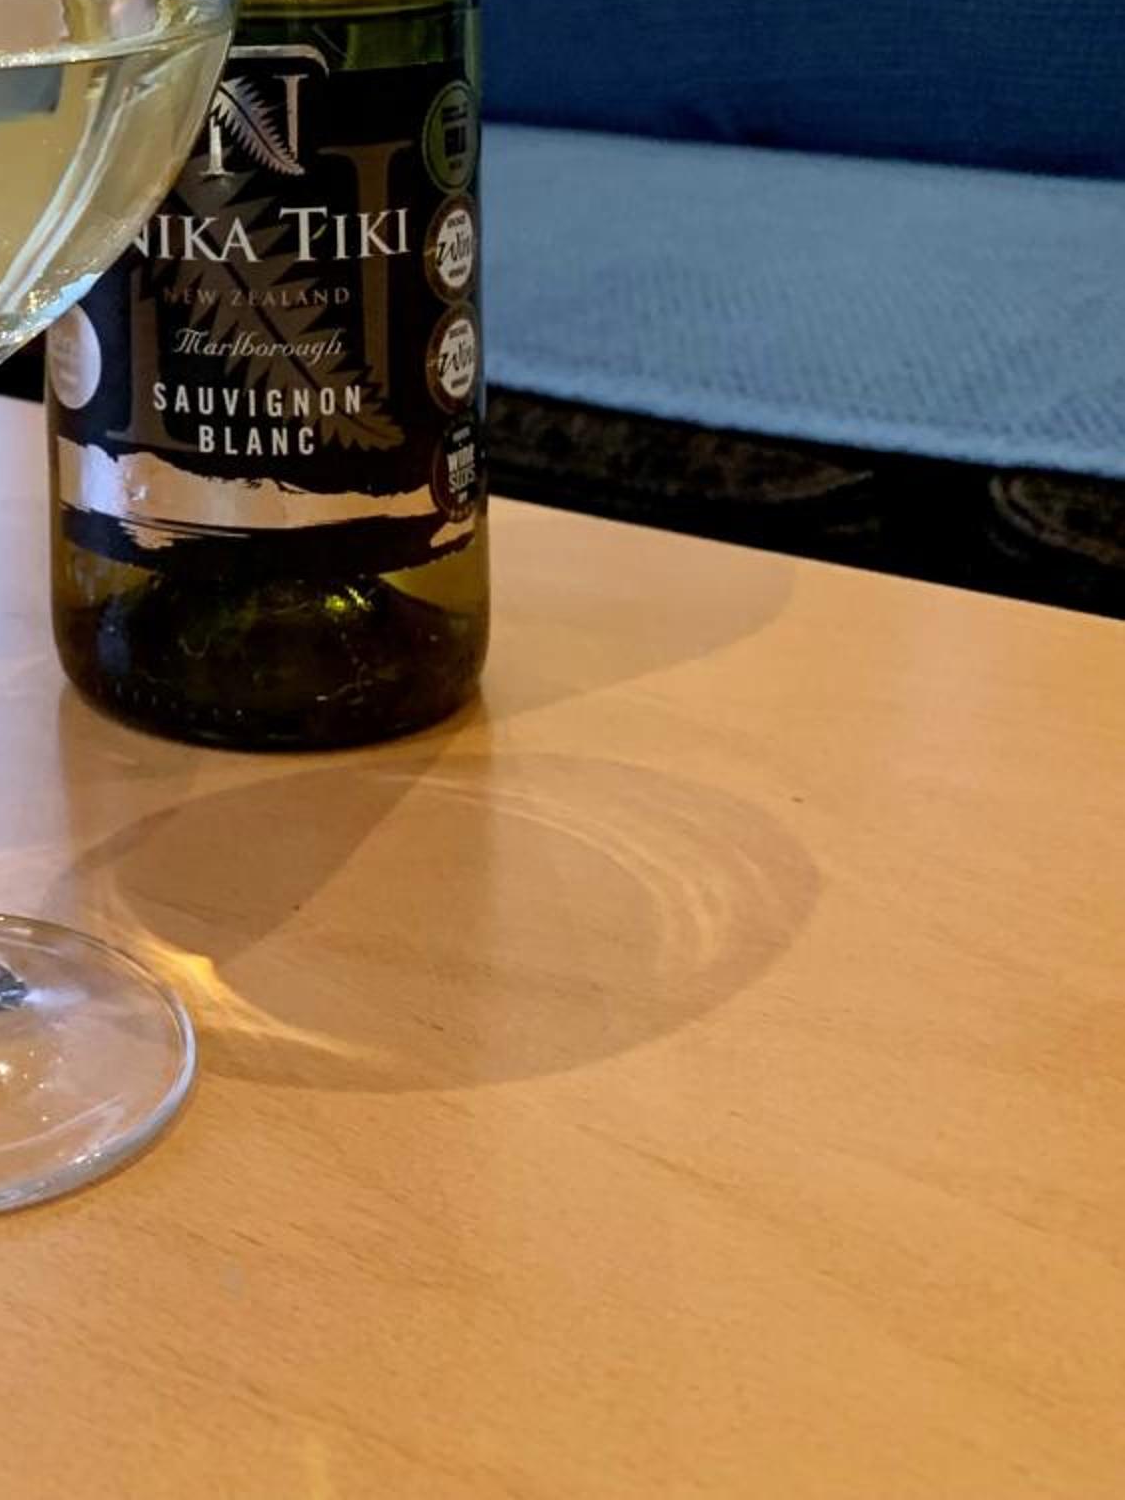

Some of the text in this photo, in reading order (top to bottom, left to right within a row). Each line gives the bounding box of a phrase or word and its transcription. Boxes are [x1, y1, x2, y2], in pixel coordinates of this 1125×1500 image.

[278, 206, 412, 263] TIKI
[163, 286, 350, 308] NEW ZEALAND
[171, 326, 346, 367] Marlborough
[153, 381, 362, 418] SAUVIGNON
[198, 424, 317, 457] BLANC
